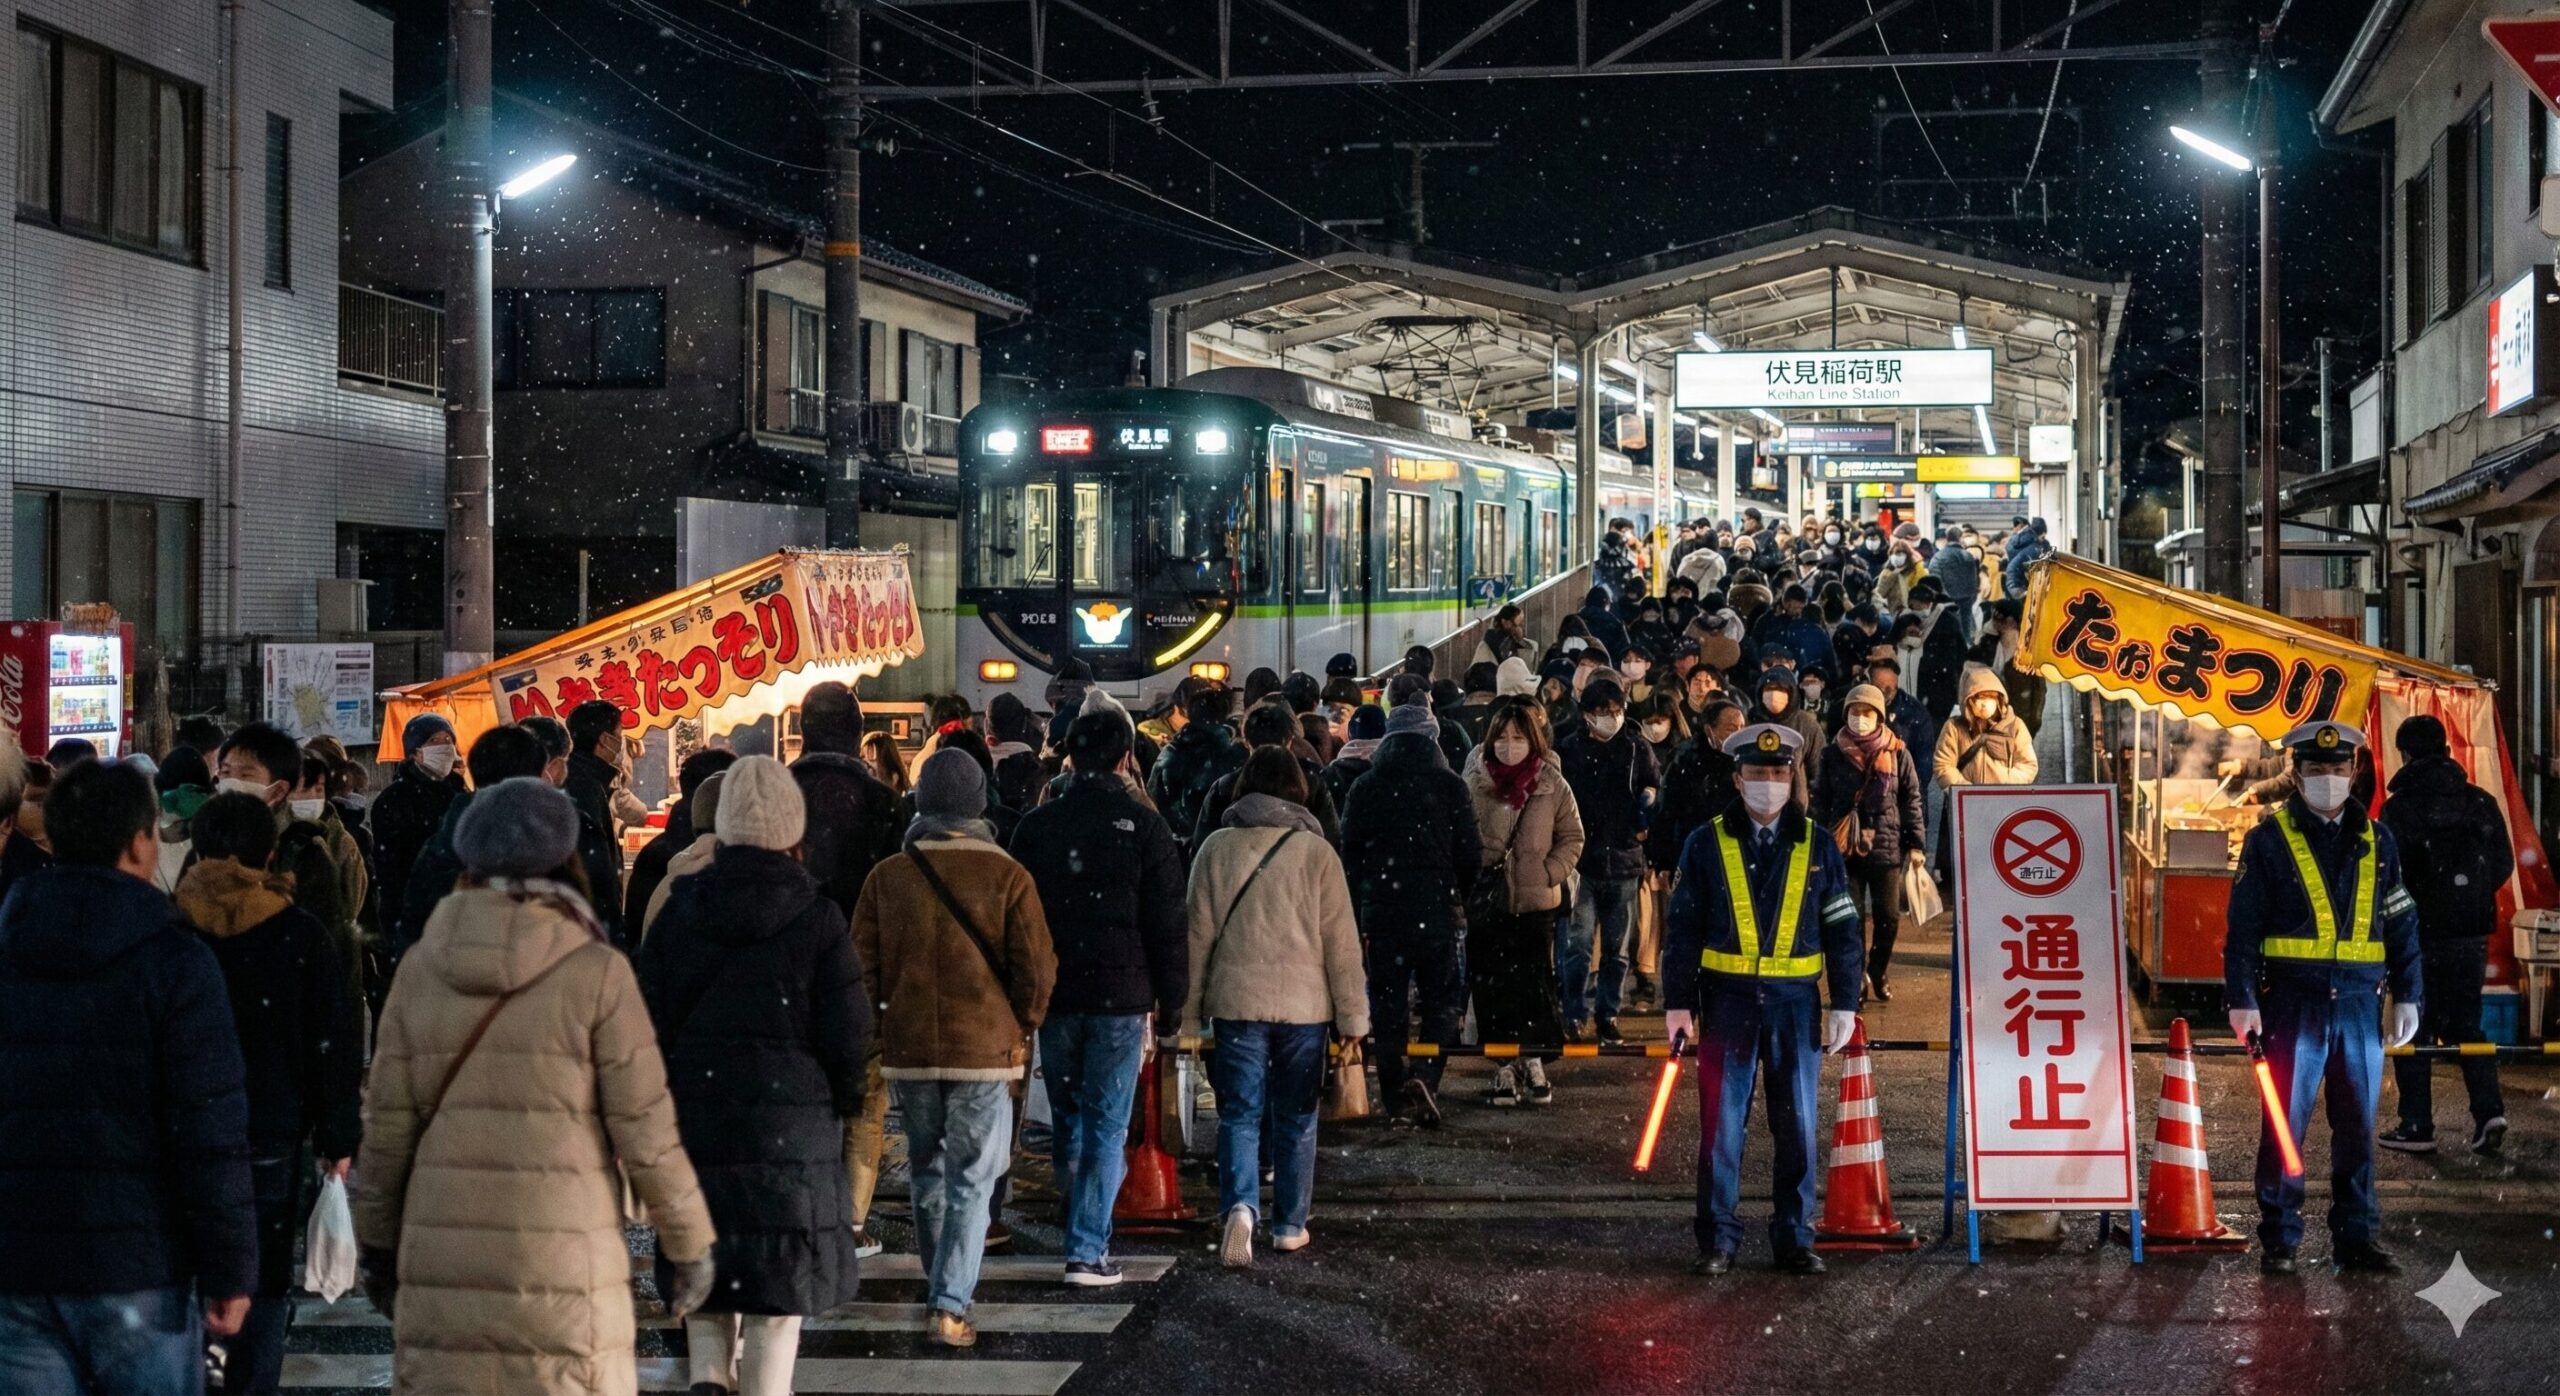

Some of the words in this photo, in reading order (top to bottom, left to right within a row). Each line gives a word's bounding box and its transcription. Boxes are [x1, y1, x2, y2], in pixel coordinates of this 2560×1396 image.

[1765, 359, 1903, 385] 伏見稲荷駅
[1767, 388, 1815, 400] Keihan
[1819, 388, 1848, 400] Line
[2000, 914, 2091, 1131] 通行止
